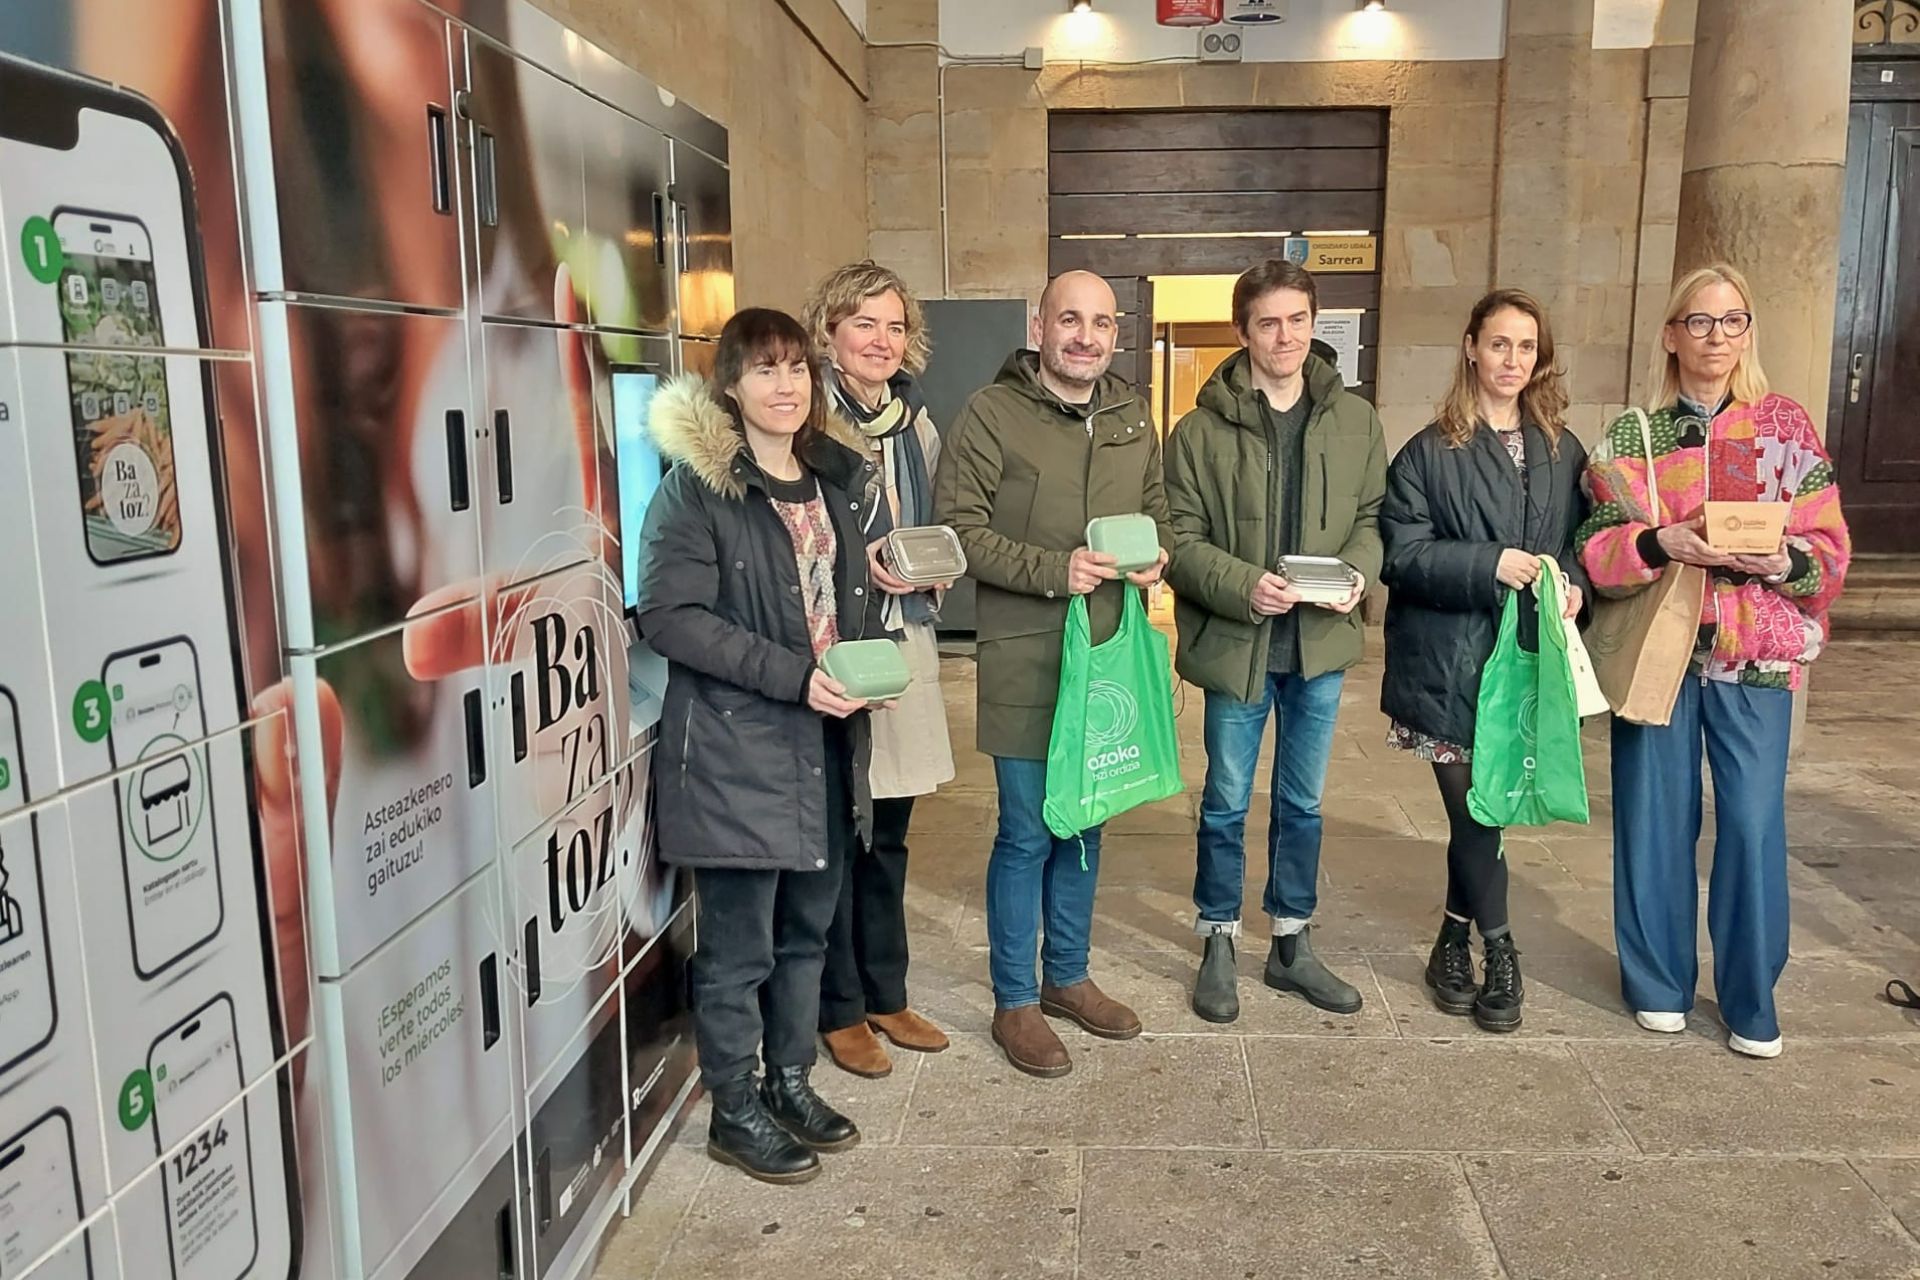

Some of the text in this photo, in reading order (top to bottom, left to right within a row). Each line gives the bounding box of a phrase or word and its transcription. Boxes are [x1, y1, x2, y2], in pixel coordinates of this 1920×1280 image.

[34, 235, 47, 268] 1
[1319, 254, 1363, 265] Sarrera
[115, 460, 136, 481] Ba
[124, 482, 141, 498] za
[120, 493, 150, 519] toz?
[530, 612, 600, 733] Ba
[84, 697, 101, 729] 3
[561, 712, 611, 816] za
[1087, 744, 1140, 771] azoka
[364, 772, 453, 834] Asteazkenero
[366, 804, 442, 864] zai edukiko
[367, 839, 424, 896] gaituzu!
[378, 958, 451, 1037] ¡Esperamos
[379, 985, 452, 1059] verte todos
[381, 993, 464, 1089] los miércoles!
[129, 1083, 144, 1117] 5
[173, 1118, 229, 1184] 1234
